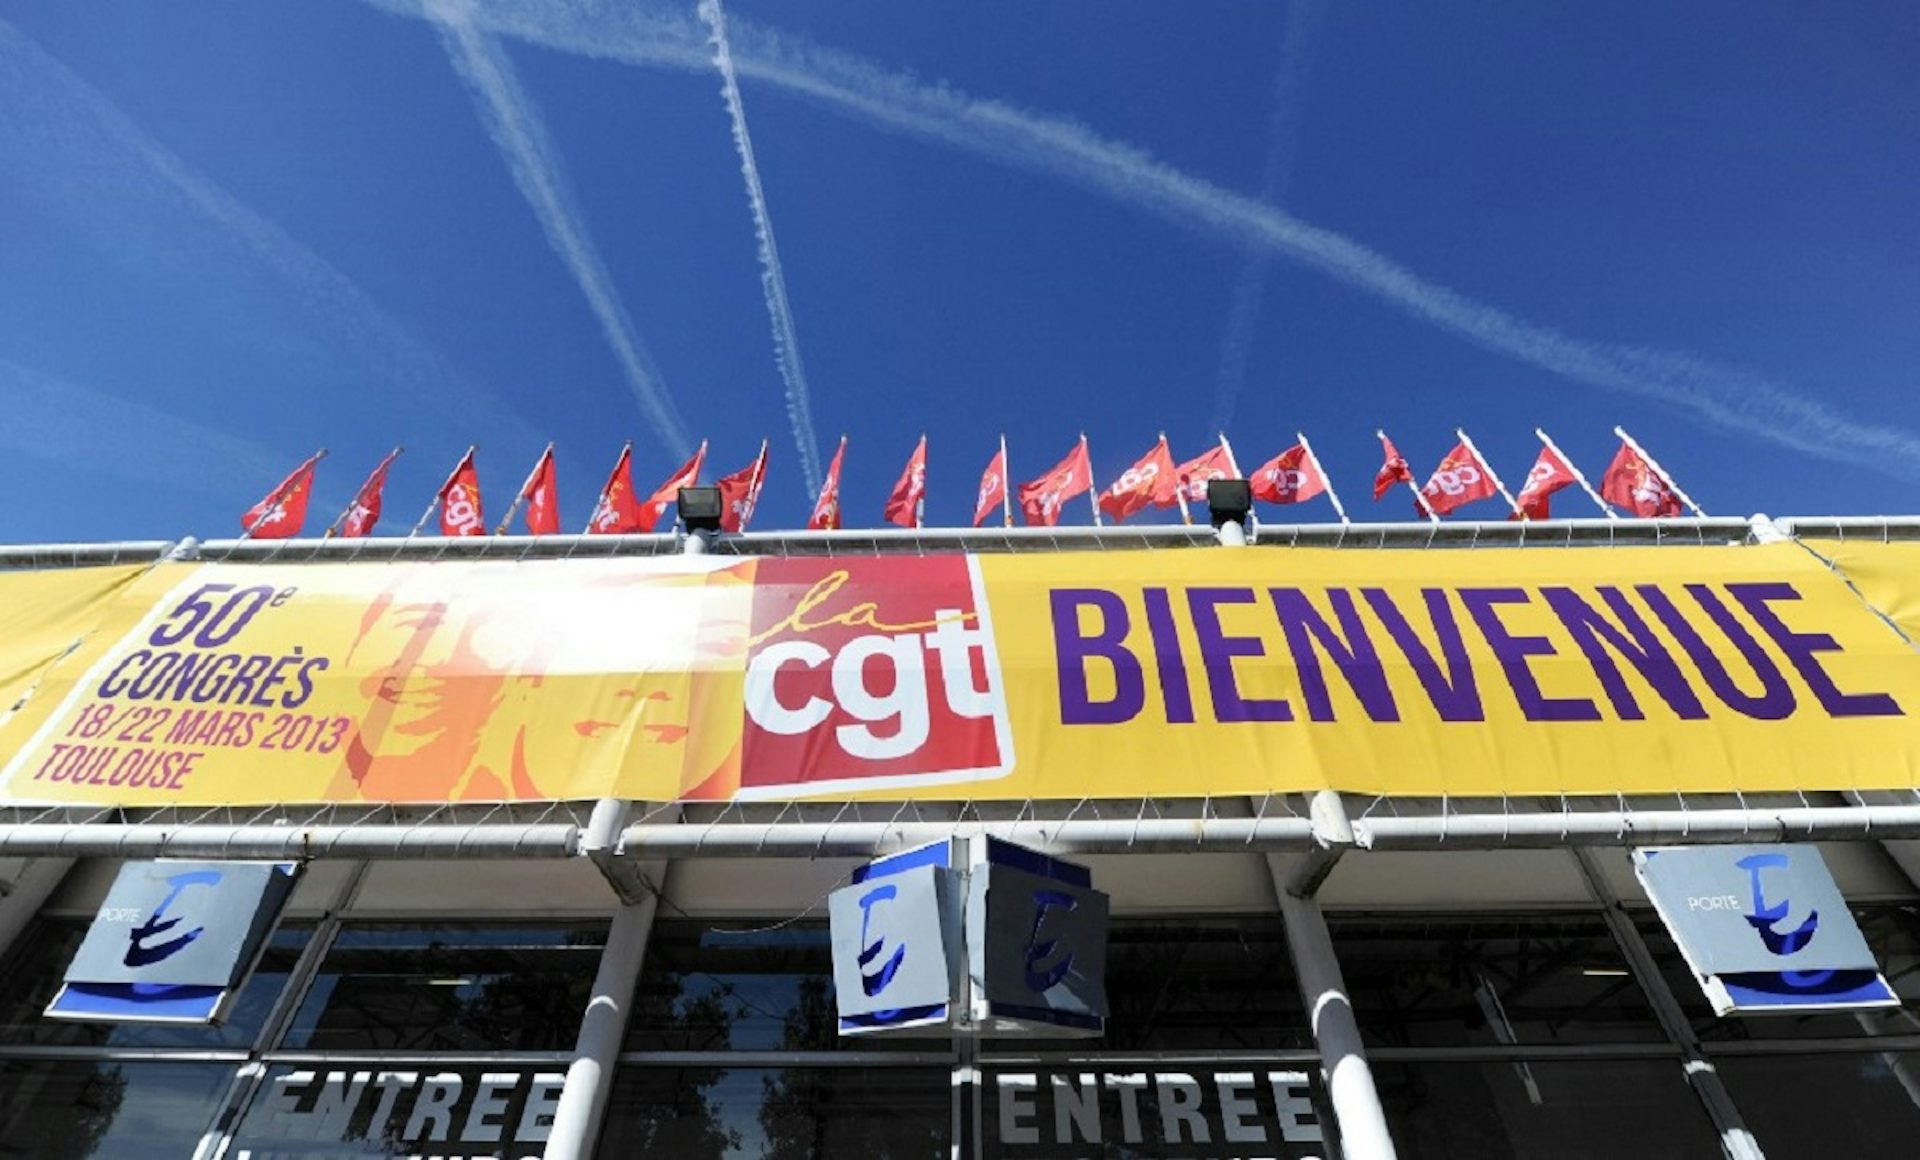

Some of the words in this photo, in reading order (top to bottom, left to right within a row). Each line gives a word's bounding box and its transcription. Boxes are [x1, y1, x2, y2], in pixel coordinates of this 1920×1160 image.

[97, 646, 330, 709] CONGRÈS
[743, 608, 992, 760] cgt
[1048, 582, 1905, 726] BIENVENUE
[65, 703, 176, 744] 18/22
[163, 712, 265, 747] MARS
[259, 713, 350, 754] 2013
[34, 743, 205, 790] TOULOUSE
[99, 908, 142, 922] PORTE
[1688, 896, 1740, 910] PORTE
[266, 1071, 567, 1142] ENTREE
[996, 1072, 1324, 1144] ENTREE
